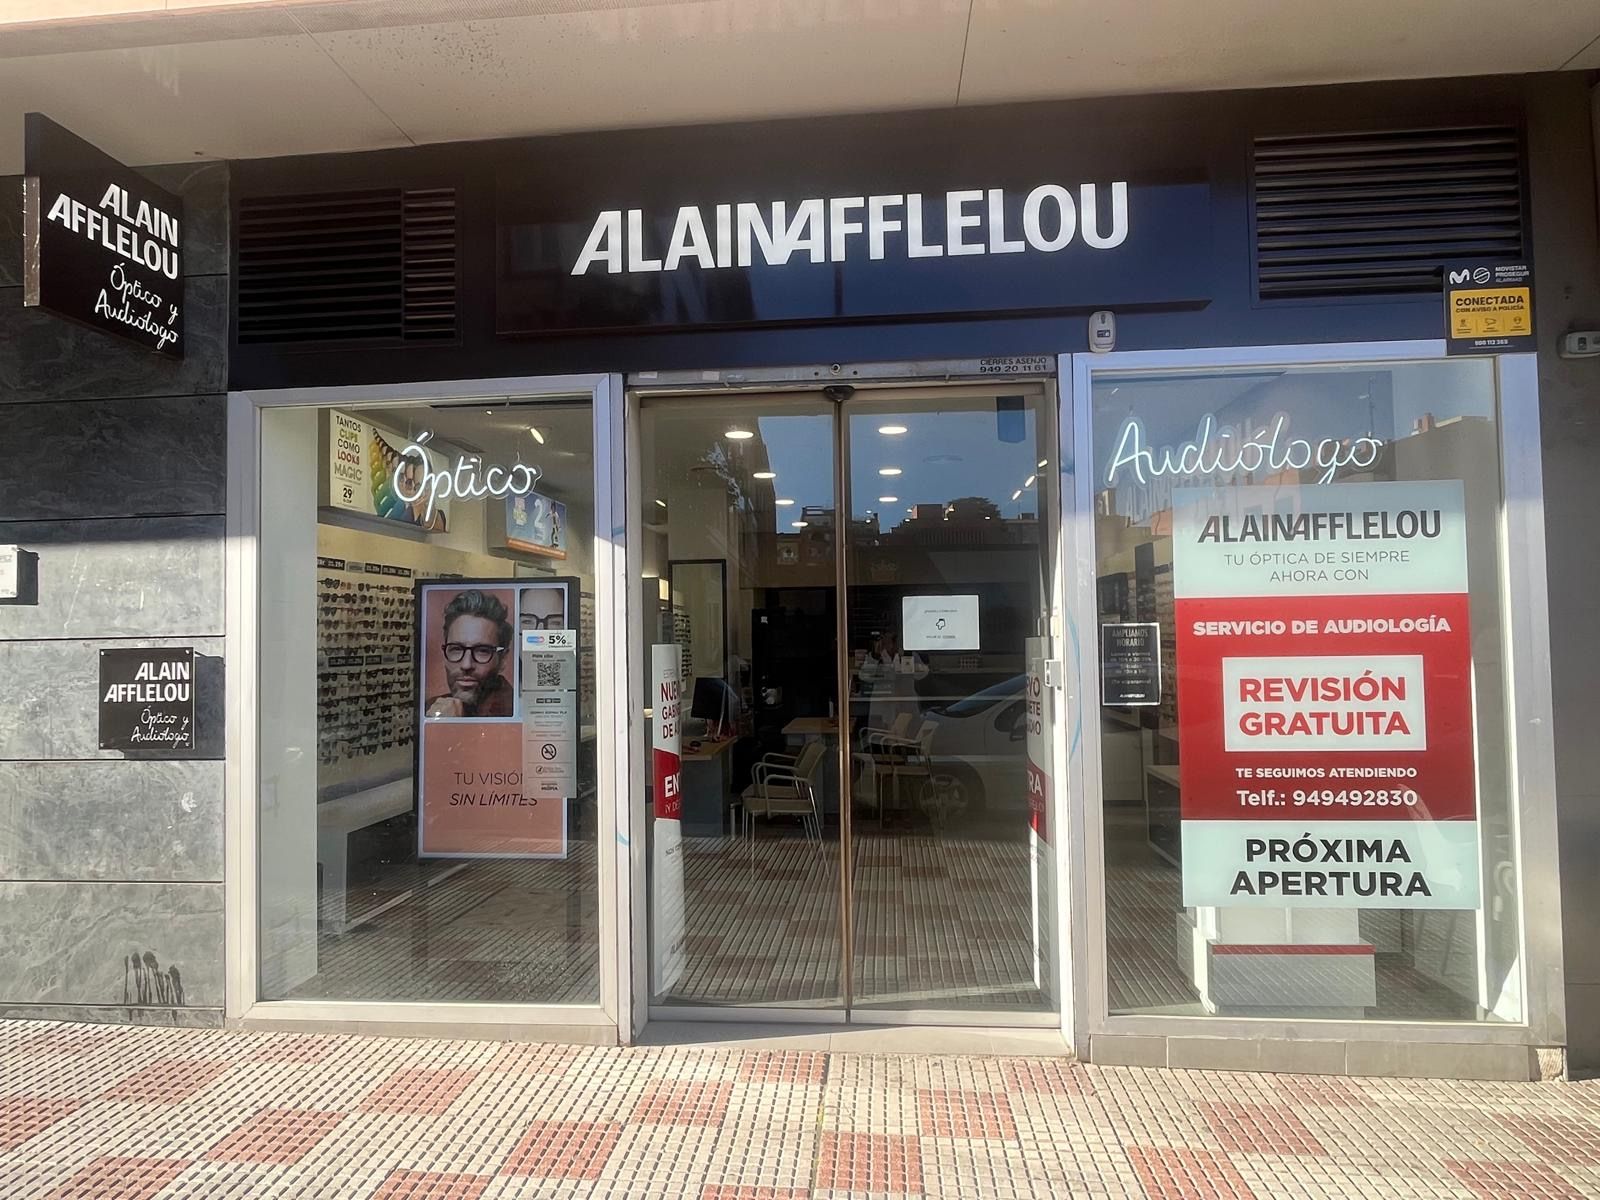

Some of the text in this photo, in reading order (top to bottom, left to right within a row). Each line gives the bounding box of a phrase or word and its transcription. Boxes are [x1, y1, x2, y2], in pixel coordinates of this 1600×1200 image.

[99, 183, 178, 247] ALAIN
[47, 193, 178, 279] AFFLELOU
[110, 262, 178, 324] Óptico y
[1456, 295, 1524, 306] CONECTADA
[94, 289, 178, 349] Audiólogo
[980, 358, 1014, 366] CIERRES
[336, 415, 361, 432] TANTOS
[340, 429, 358, 442] CLIPS
[337, 438, 360, 454] COMO
[1107, 415, 1384, 486] Audiólogo
[337, 450, 360, 465] LOOKS
[334, 462, 363, 481] MAGIC
[393, 431, 536, 522] Óptico
[343, 487, 353, 499] 29
[1224, 550, 1410, 566] TU ÓPTICA DE SIEMPRE
[1269, 568, 1369, 582] AHORA CON
[1193, 614, 1451, 636] SERVICIO DE AUDIOLOGÍA
[549, 635, 567, 644] 5%
[135, 662, 190, 681] ALAIN
[104, 683, 190, 702] AFFLELOU
[1239, 669, 1406, 703] REVISIÓN
[141, 705, 190, 730] Óptico y
[1239, 711, 1410, 736] GRATUITA
[131, 726, 190, 749] Audiólogo
[663, 724, 673, 739] DE
[454, 772, 474, 785] TU
[1236, 767, 1417, 778] TE SEGUIMOS ATENDIENDO
[449, 790, 538, 806] SIN LÍMITES
[1236, 789, 1418, 806] Telf.: 949492830
[1246, 833, 1412, 864] PRÓXIMA
[1230, 871, 1432, 897] APERTURA
